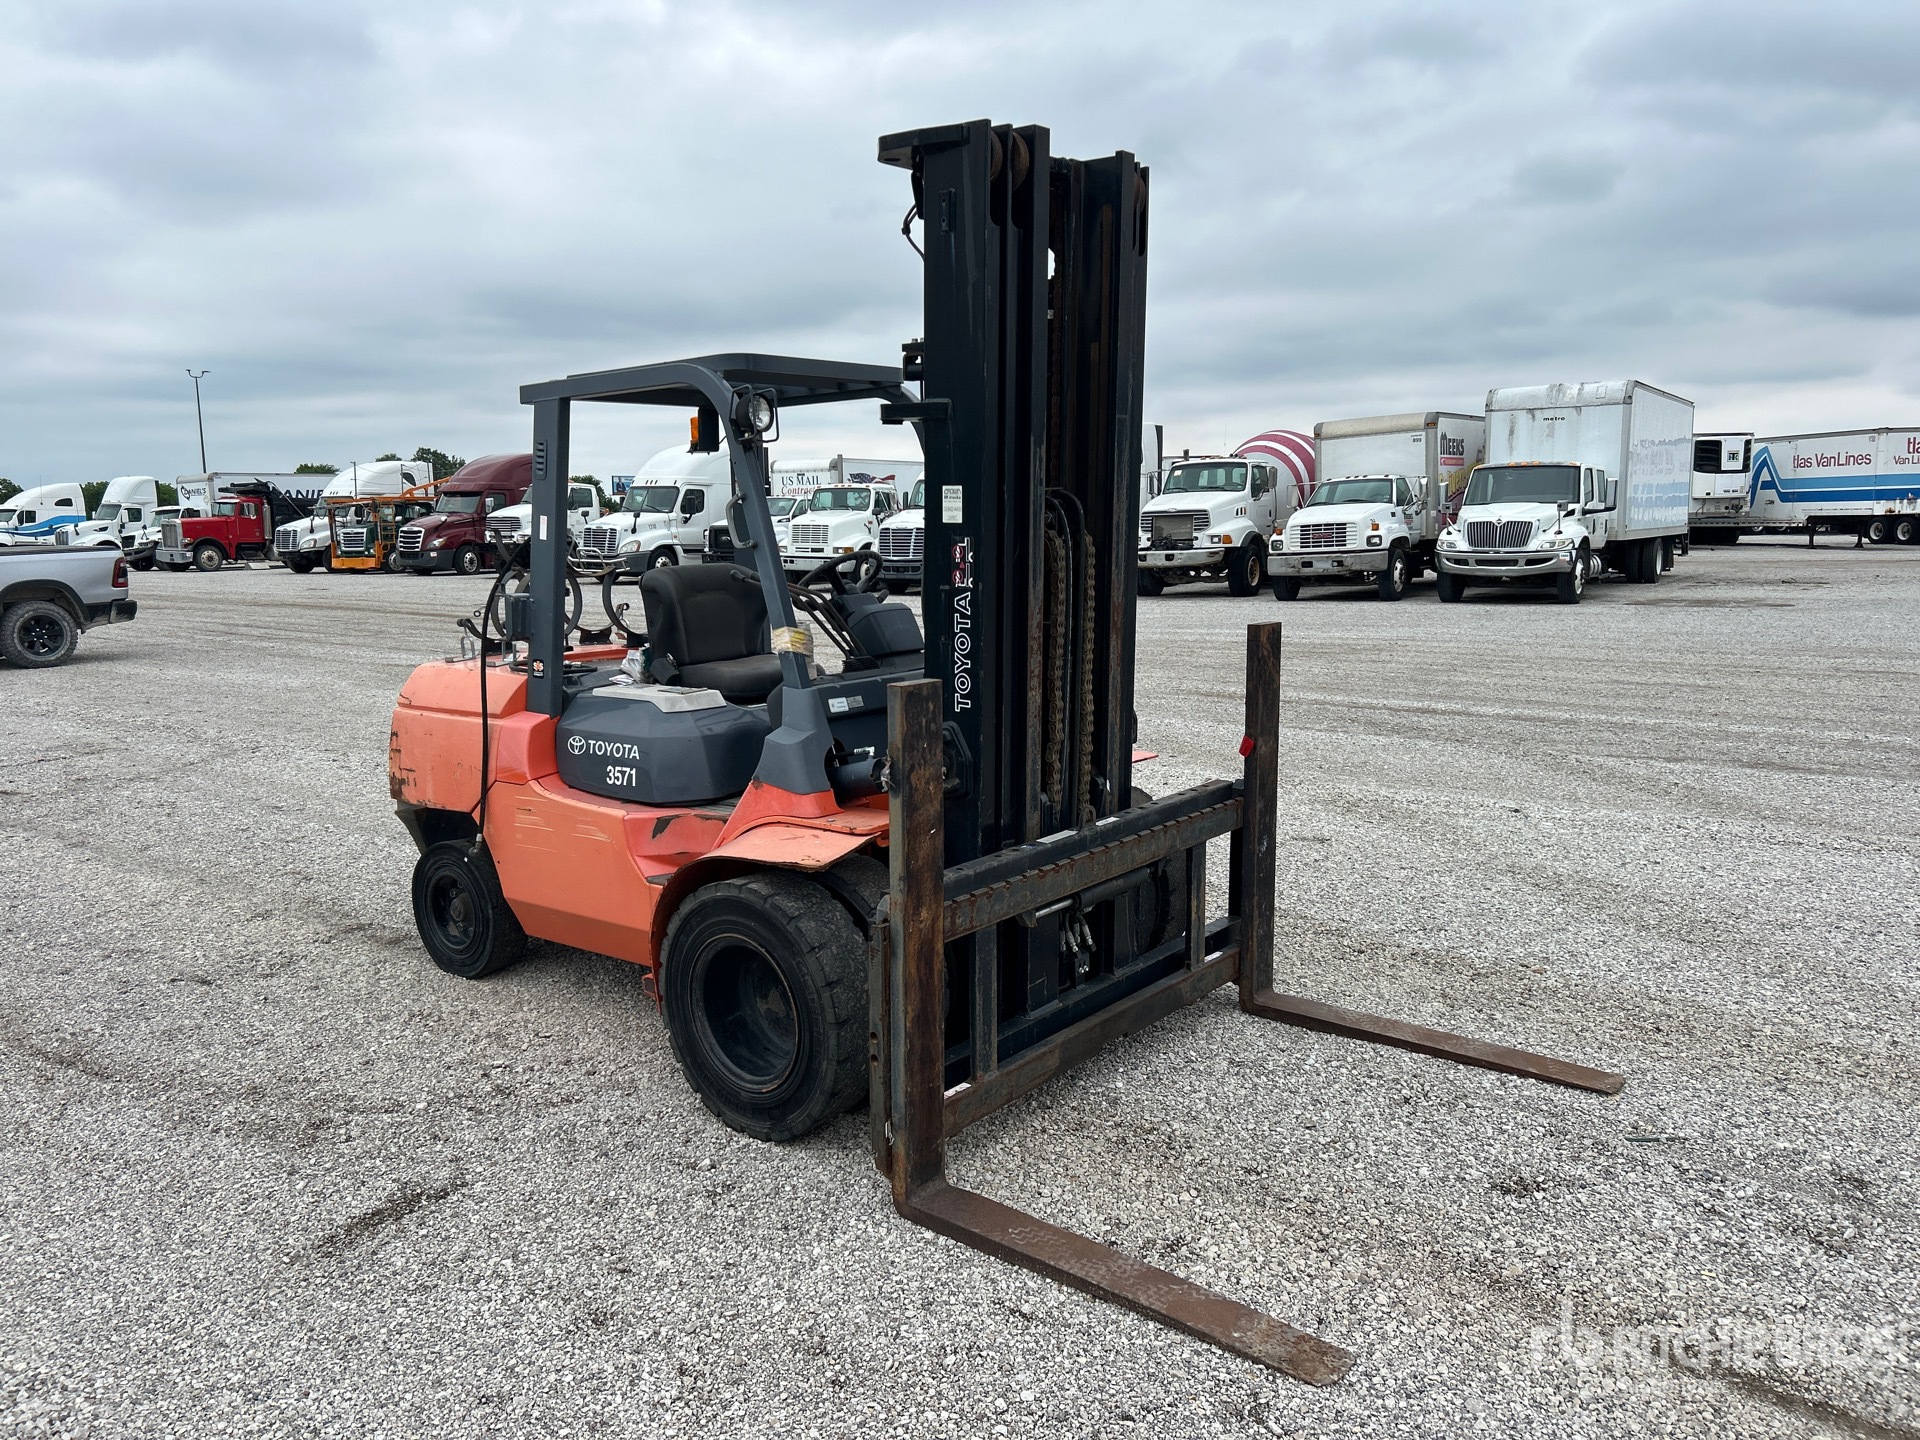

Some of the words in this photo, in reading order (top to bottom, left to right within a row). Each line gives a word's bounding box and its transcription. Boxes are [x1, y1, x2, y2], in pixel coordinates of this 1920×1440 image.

[1440, 432, 1464, 456] MEEKS
[1894, 455, 1910, 465] Van
[781, 476, 794, 486] US
[796, 475, 822, 486] MAIL
[954, 592, 971, 712] TOYOTA
[588, 739, 640, 760] TOYOTA
[606, 765, 636, 787] 3571
